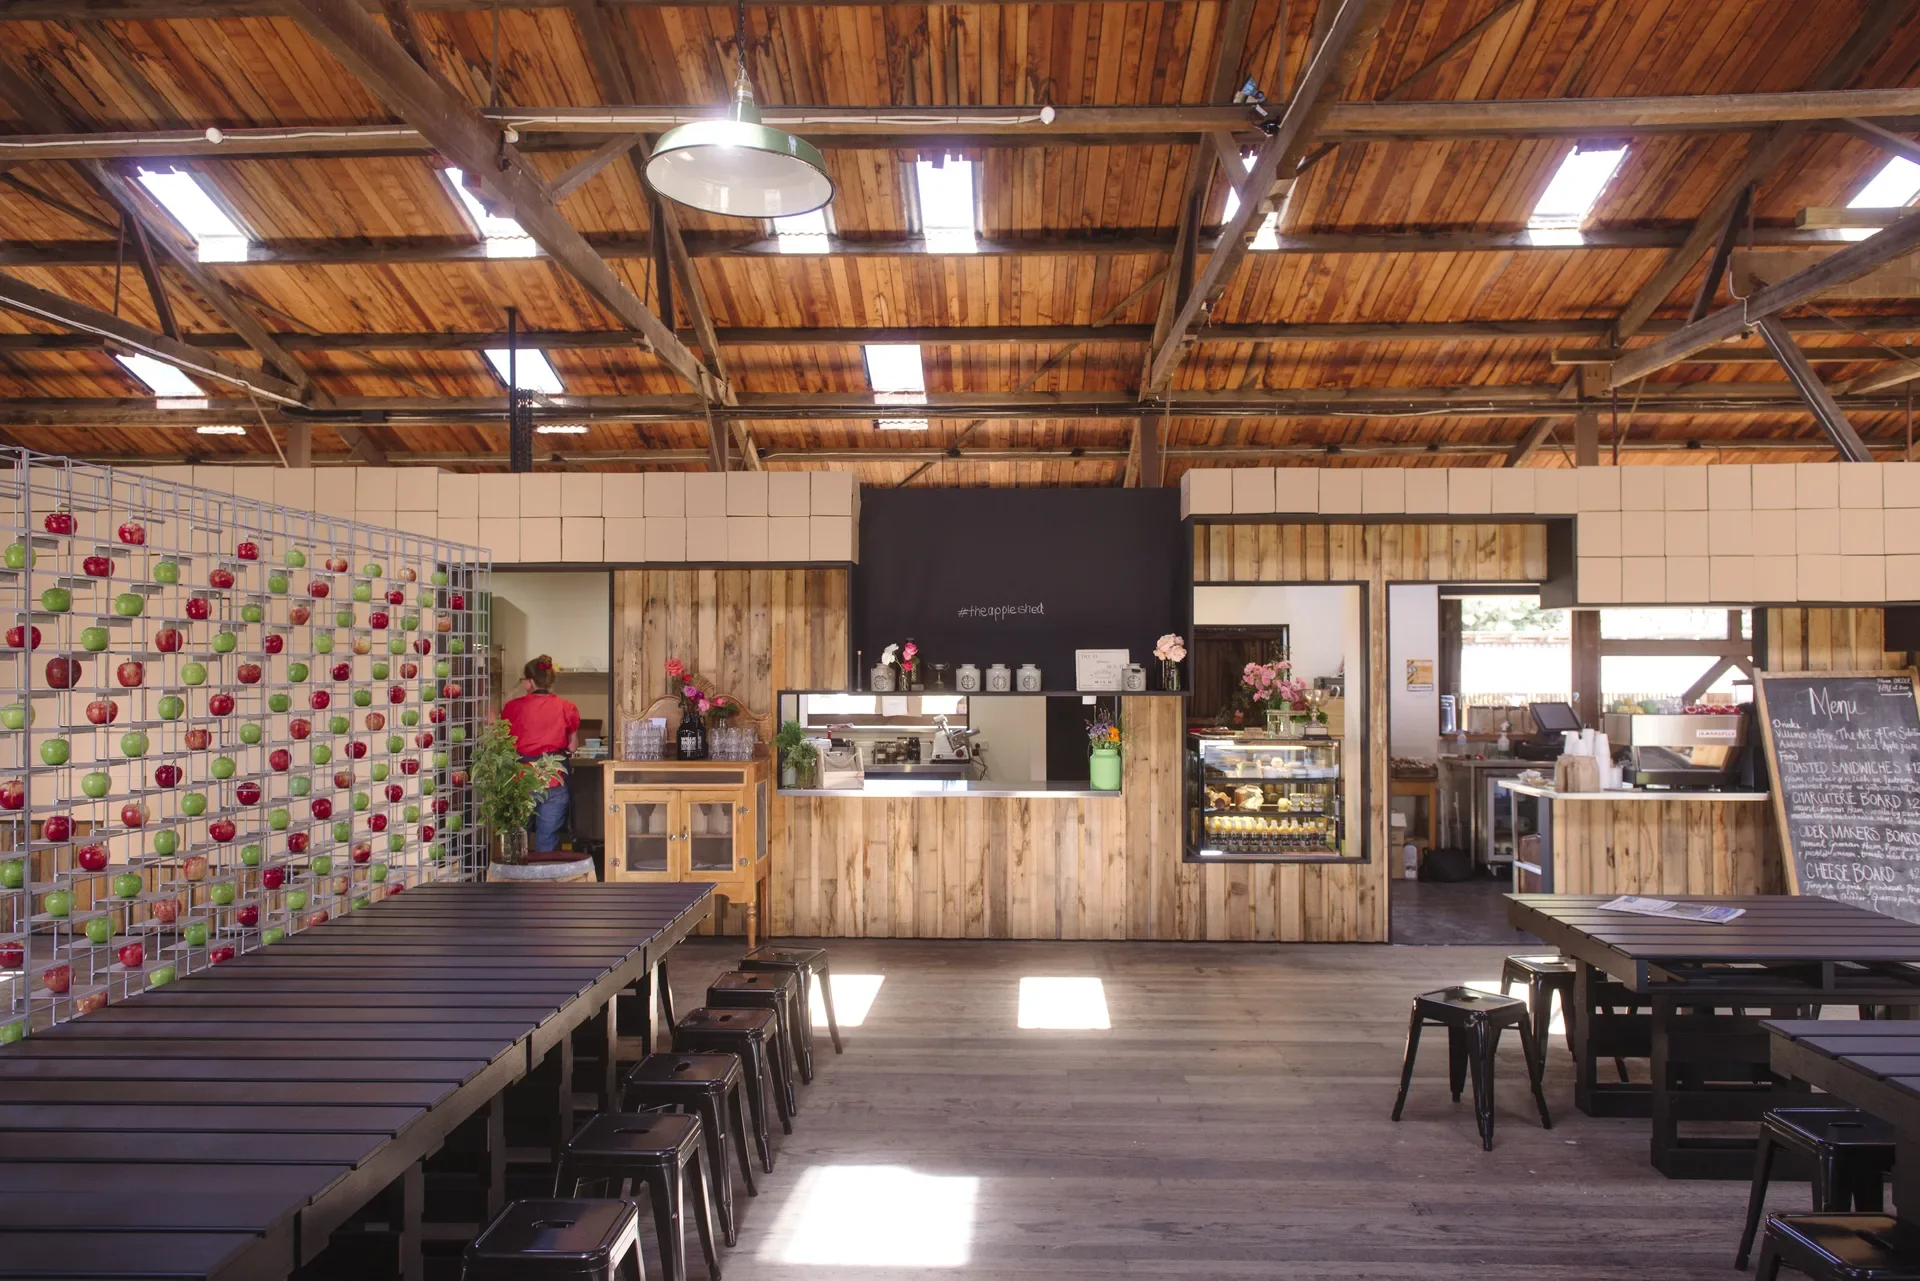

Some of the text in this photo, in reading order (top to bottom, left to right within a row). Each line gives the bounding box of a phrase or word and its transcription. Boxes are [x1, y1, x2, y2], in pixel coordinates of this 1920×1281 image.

[1808, 686, 1867, 721] Menu
[1856, 739, 1880, 751] Local
[1778, 751, 1799, 761] Food
[1786, 761, 1828, 774] TOASTED
[1831, 761, 1902, 775] SANDWICHES
[1792, 792, 1857, 805] CHARCUTERIE
[1860, 793, 1901, 809] BOARD
[1830, 825, 1881, 841] MAKERS
[1885, 828, 1920, 845] BOARD
[1805, 863, 1850, 882] CHEESE
[1852, 862, 1896, 883] BOARD
